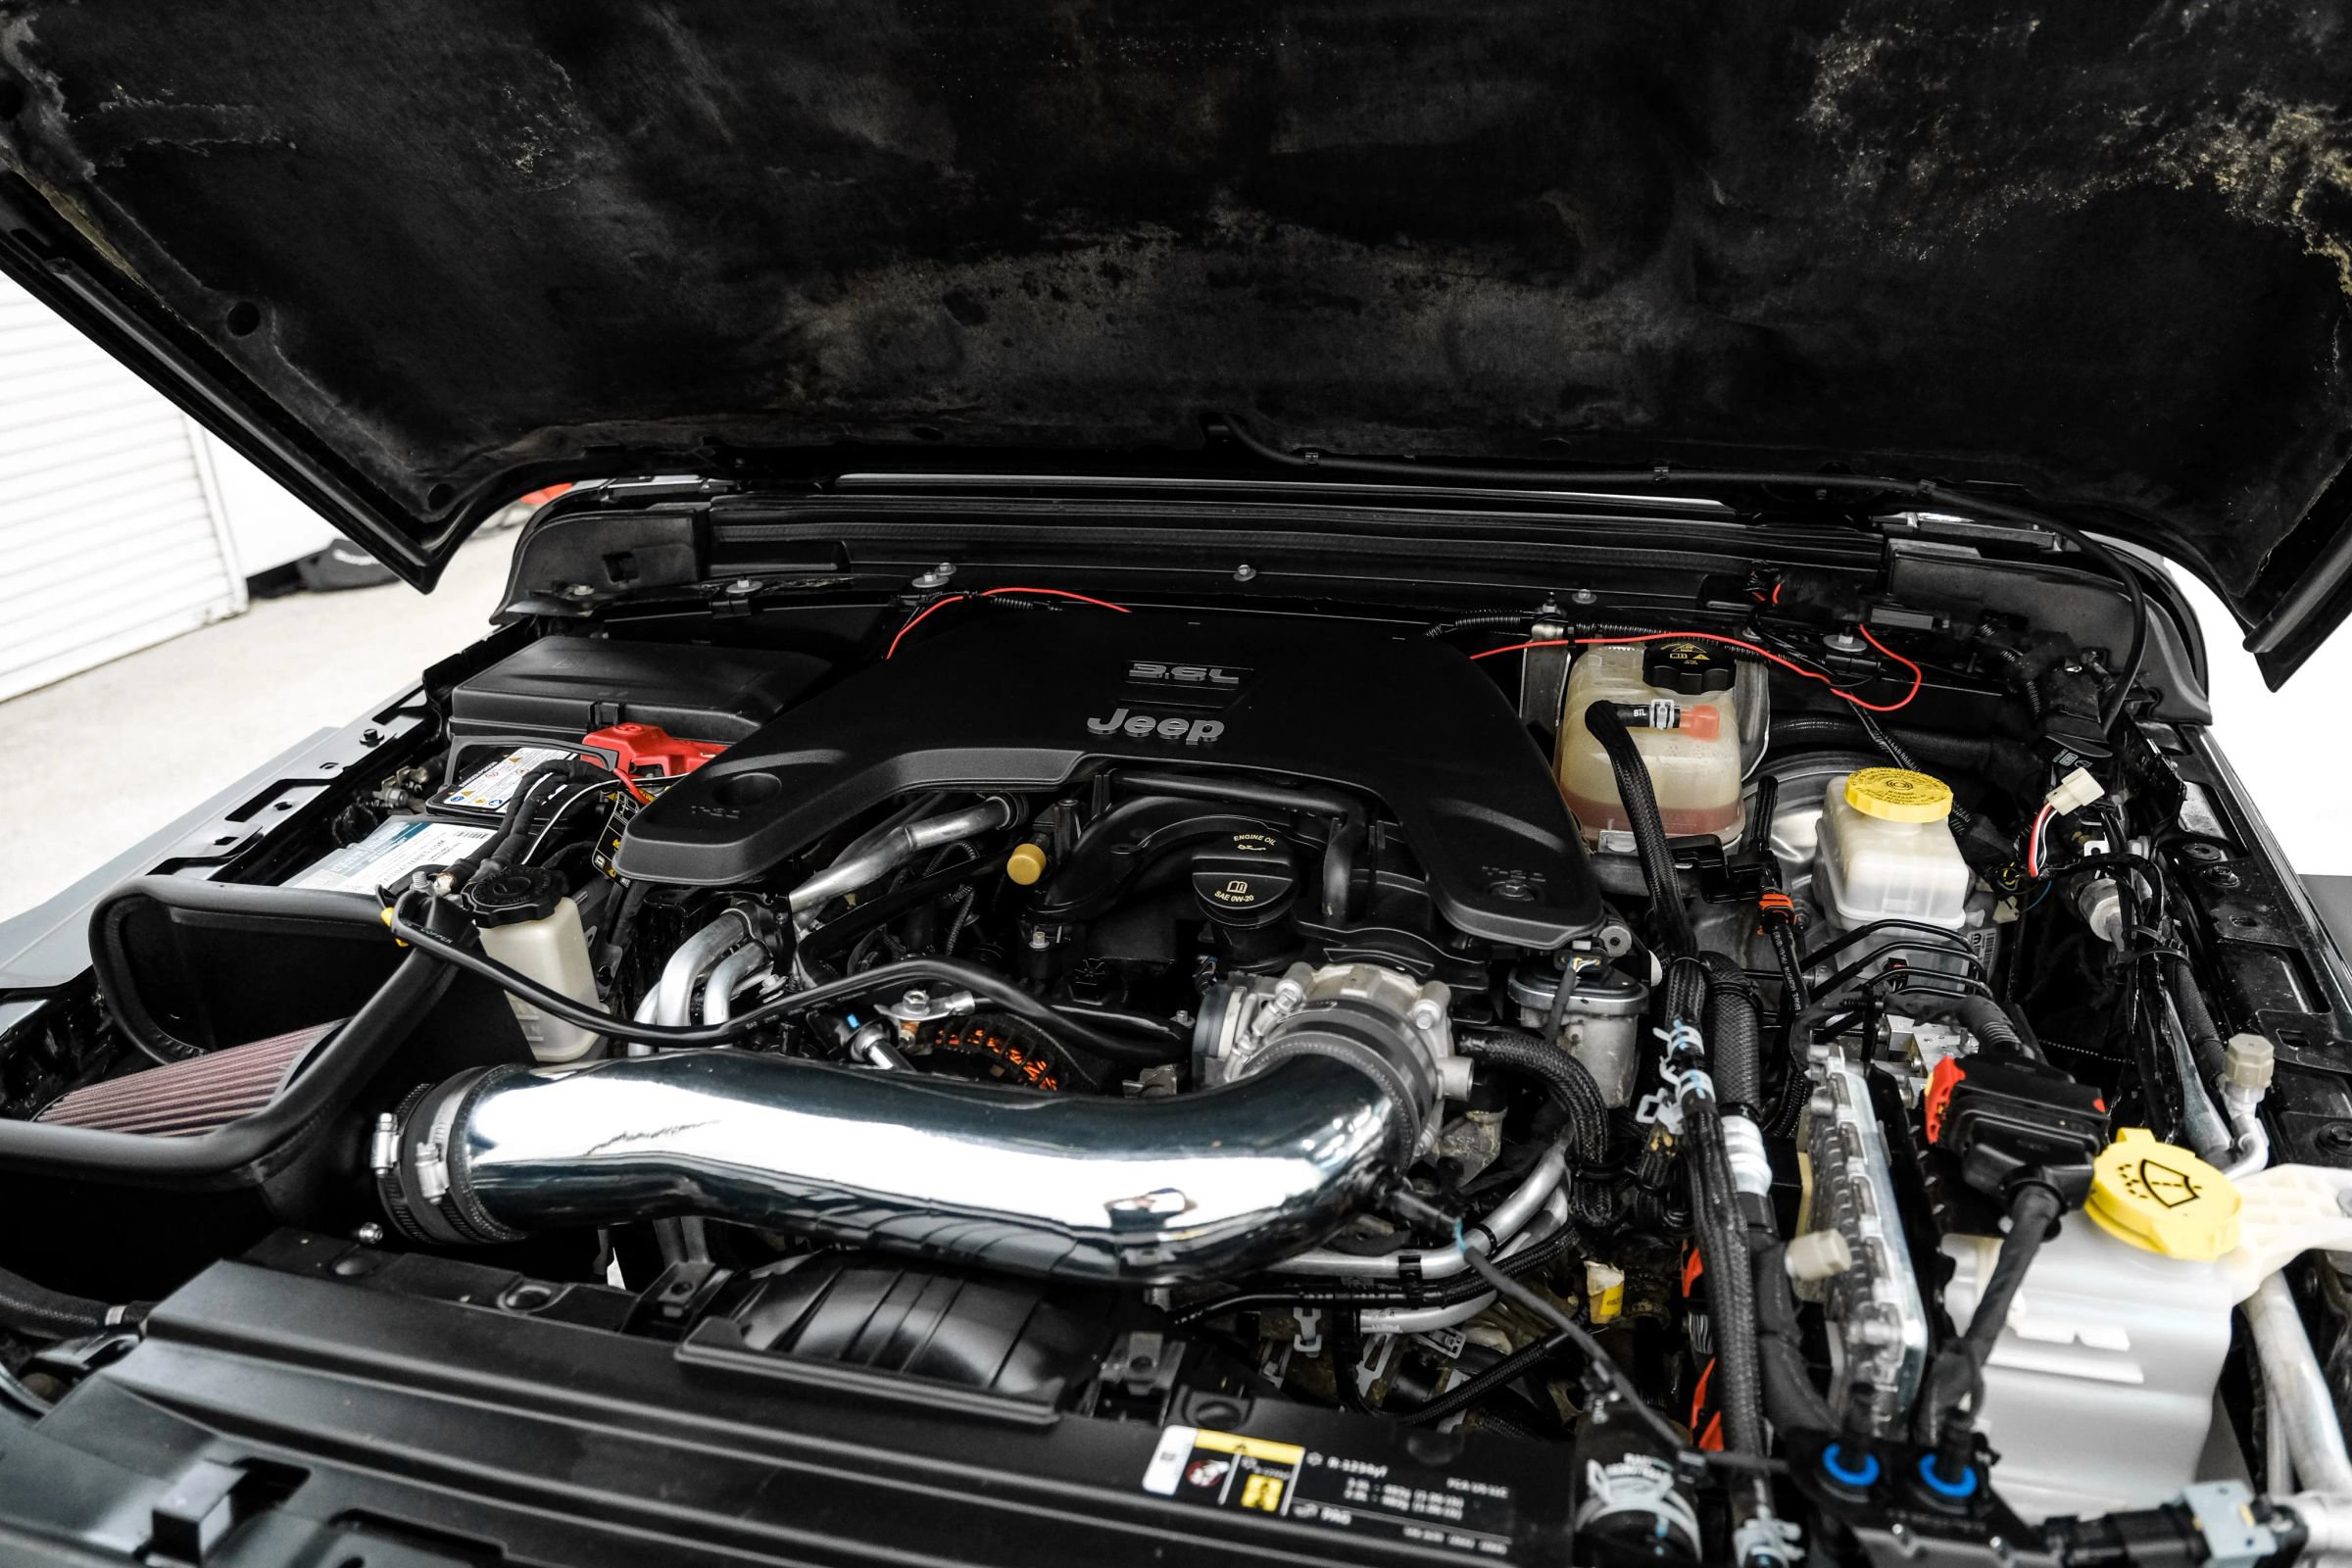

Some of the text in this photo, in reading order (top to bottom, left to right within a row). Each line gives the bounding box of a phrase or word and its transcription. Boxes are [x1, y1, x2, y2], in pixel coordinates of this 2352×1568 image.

[1128, 662, 1240, 684] 3.6L
[1087, 708, 1225, 746] Jeep
[1233, 833, 1277, 846] ENGINE OIL
[1214, 890, 1230, 902] SAE
